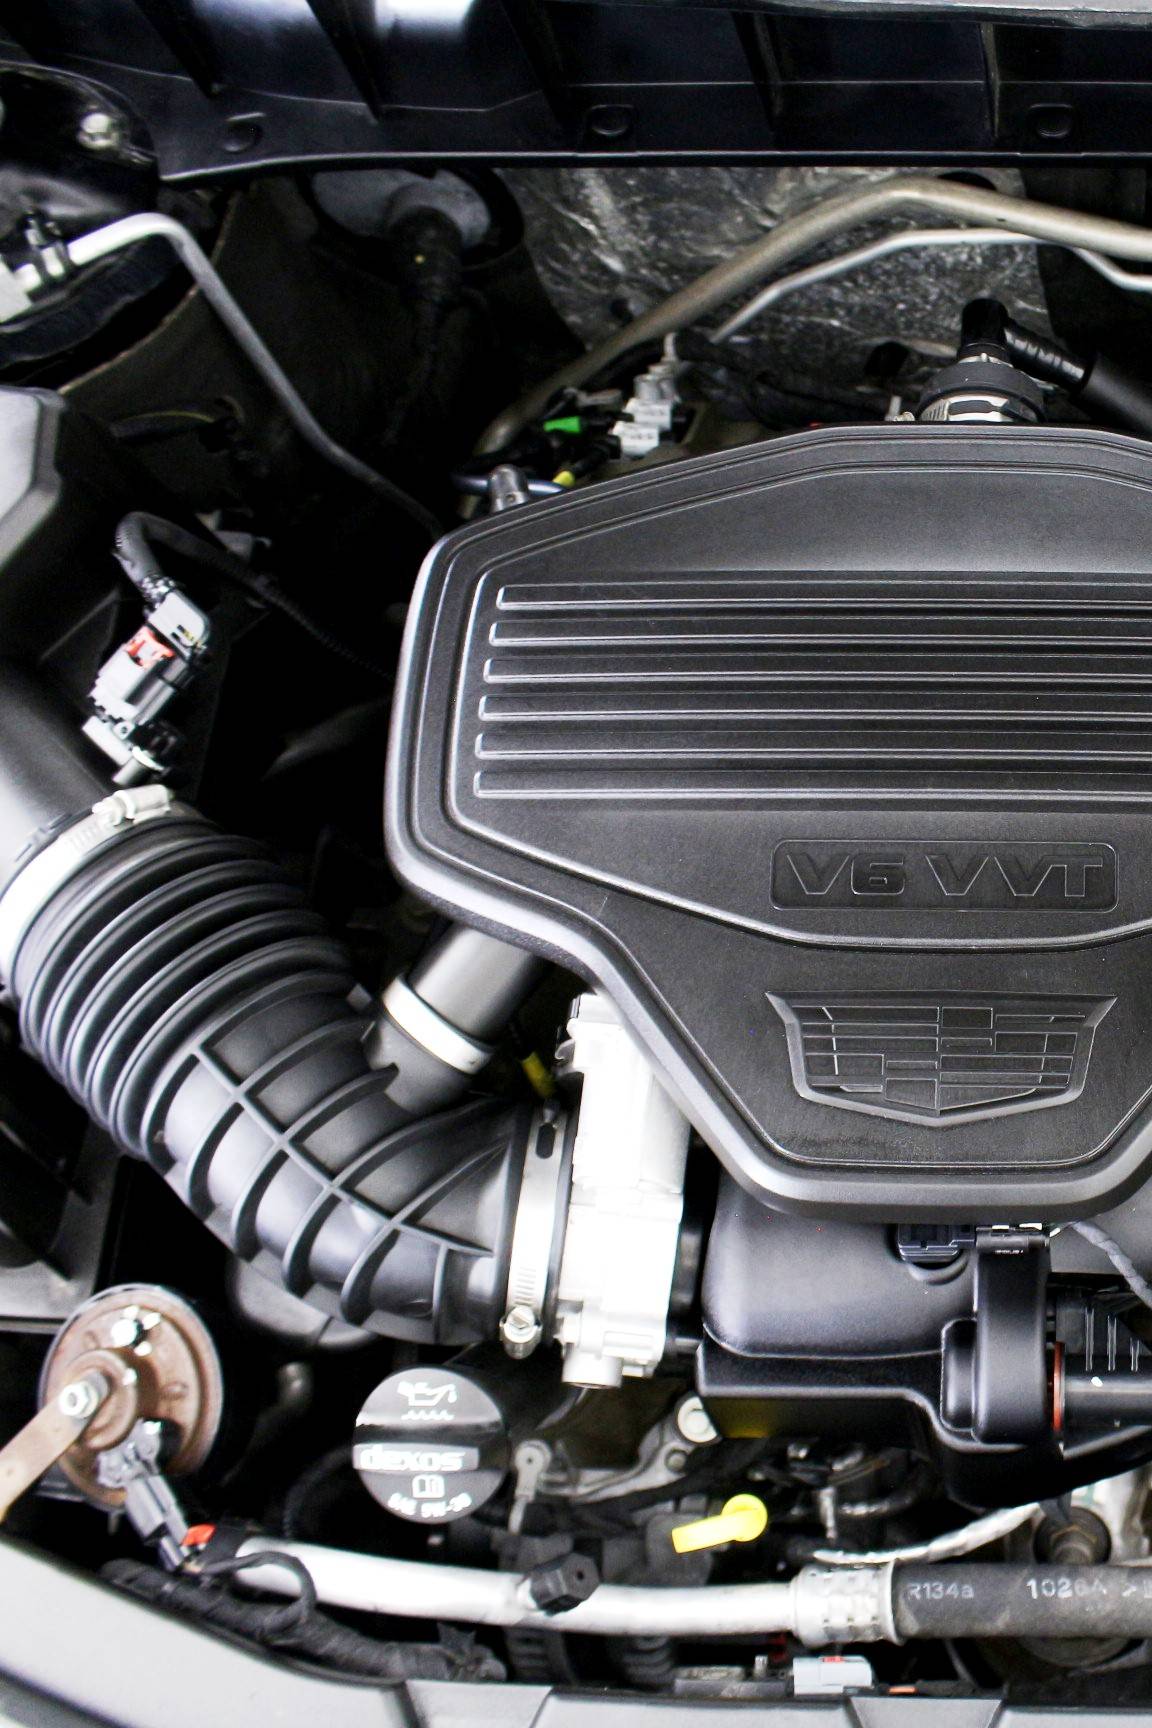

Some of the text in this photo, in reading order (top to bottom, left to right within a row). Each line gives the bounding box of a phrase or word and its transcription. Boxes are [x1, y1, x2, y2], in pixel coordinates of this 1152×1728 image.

[787, 854, 1103, 897] V6 VVT
[360, 1444, 466, 1471] dexos
